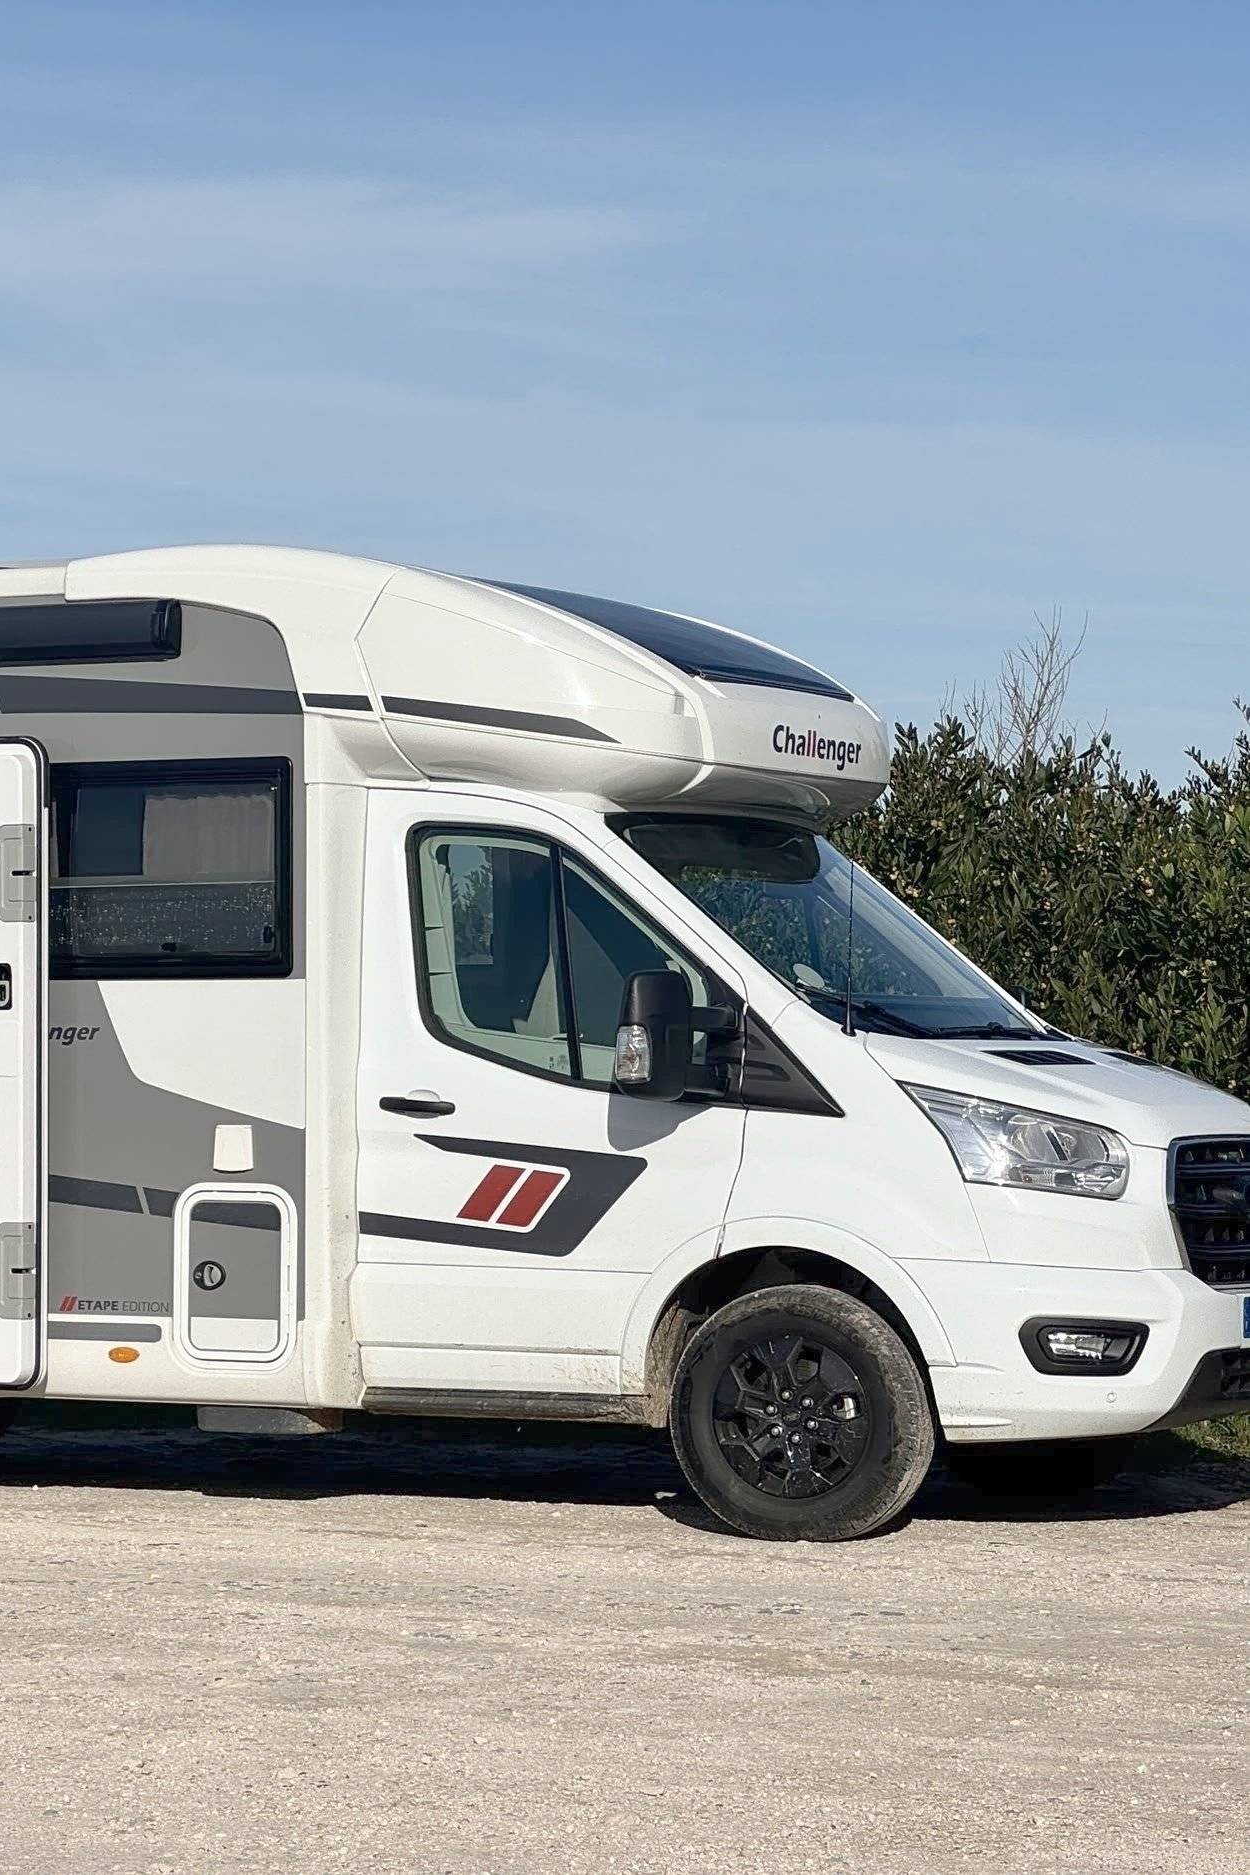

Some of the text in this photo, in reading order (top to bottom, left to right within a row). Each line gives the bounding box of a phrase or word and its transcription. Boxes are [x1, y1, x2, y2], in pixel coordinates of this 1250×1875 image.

[772, 724, 862, 771] Challenger
[78, 1300, 169, 1312] ETAPE EDITION
